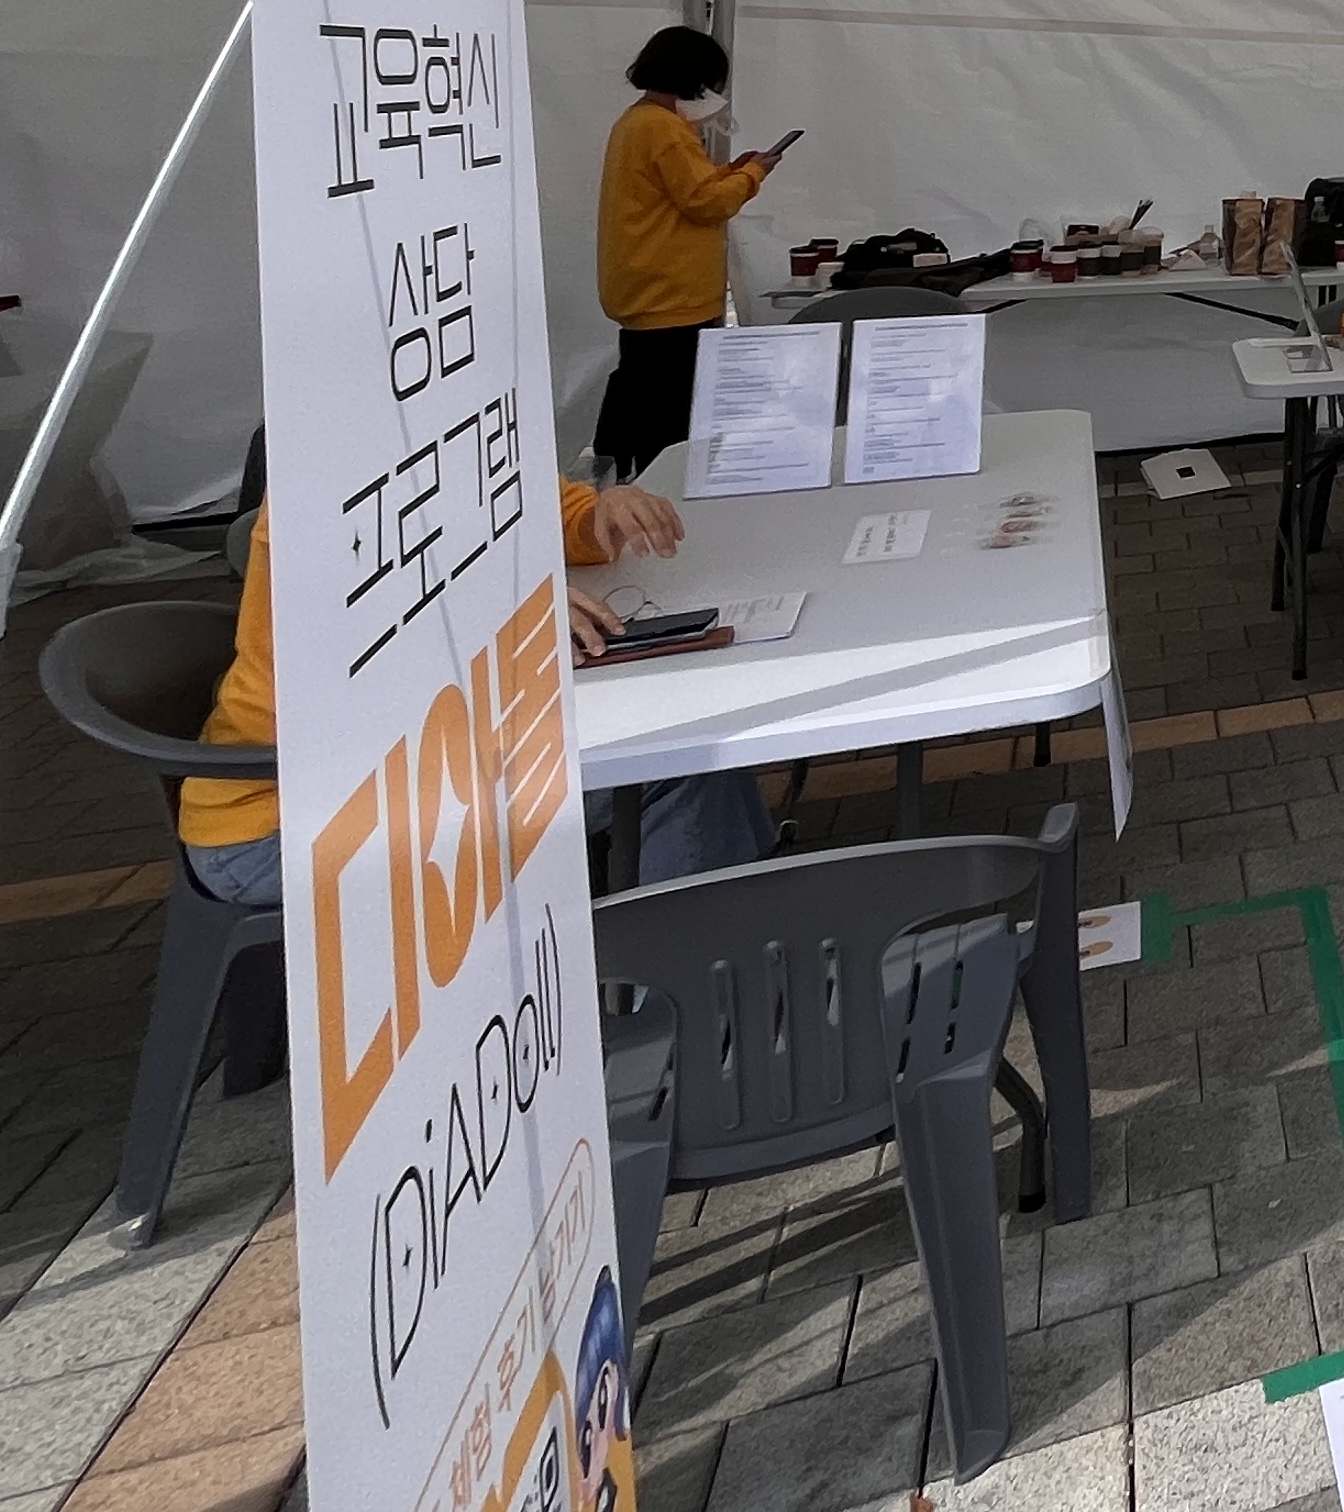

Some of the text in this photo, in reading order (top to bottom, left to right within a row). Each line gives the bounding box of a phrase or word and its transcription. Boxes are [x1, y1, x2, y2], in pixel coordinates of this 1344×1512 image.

[318, 23, 502, 200] 교육혁신
[388, 222, 476, 403] 상담
[341, 387, 524, 681] 프로그램
[311, 571, 569, 1187] 디아돌
